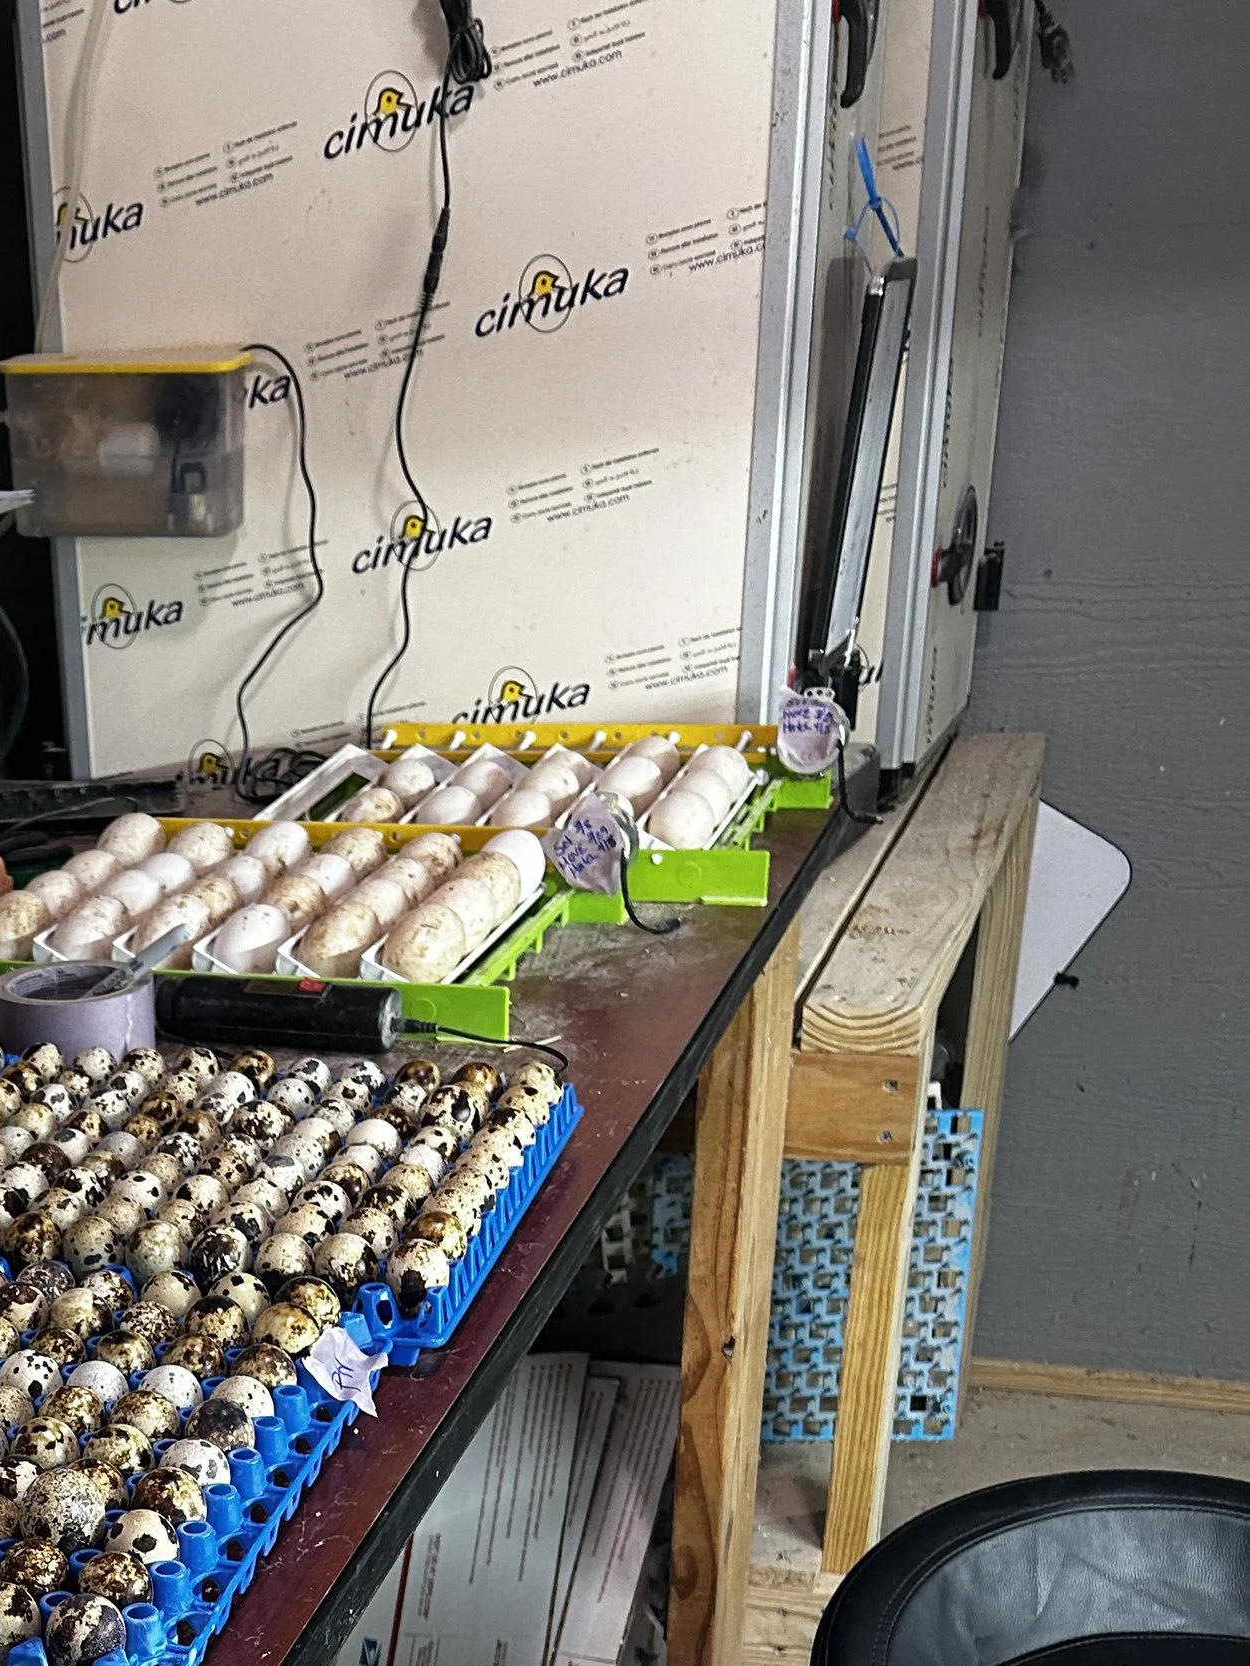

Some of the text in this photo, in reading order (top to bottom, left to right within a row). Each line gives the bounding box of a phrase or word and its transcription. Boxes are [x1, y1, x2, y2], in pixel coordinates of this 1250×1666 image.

[532, 49, 623, 87] www.cimuka.com
[323, 82, 476, 160] cimuka
[475, 264, 630, 338] cimuka
[351, 514, 494, 574] cimuka
